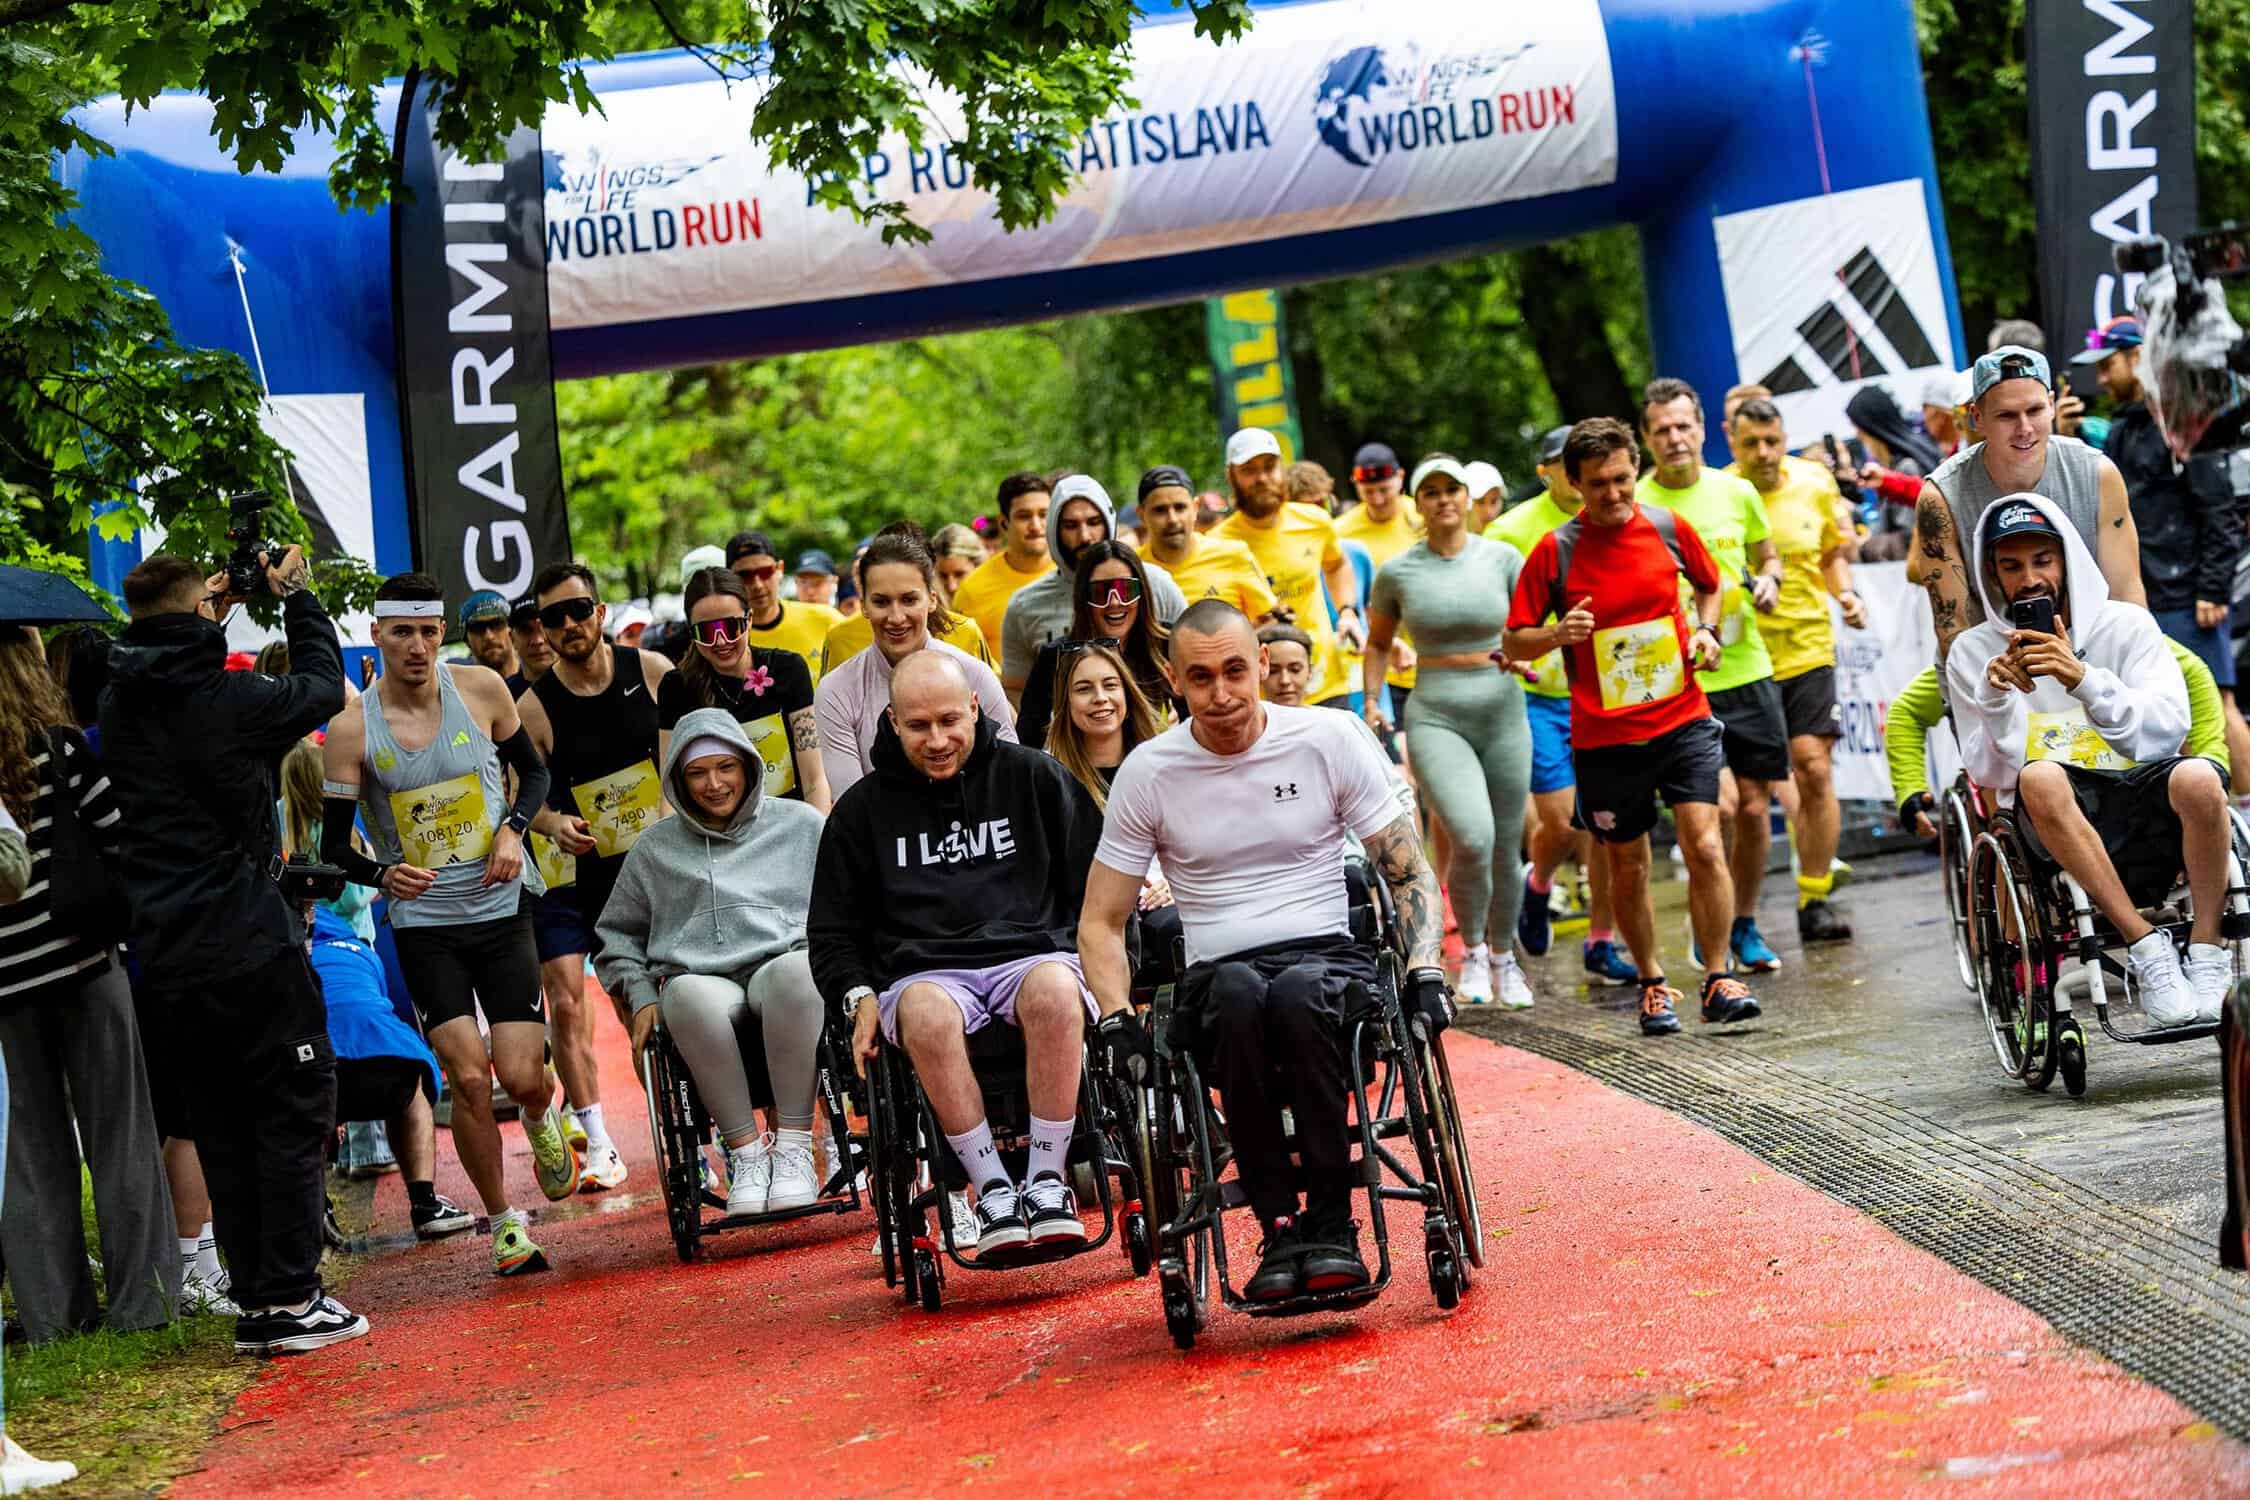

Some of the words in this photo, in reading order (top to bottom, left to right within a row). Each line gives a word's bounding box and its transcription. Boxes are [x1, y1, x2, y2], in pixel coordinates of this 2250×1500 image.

[1359, 97, 1495, 156] WORLD
[1500, 84, 1576, 134] RUN
[907, 136, 998, 194] RU
[1014, 100, 1272, 178] ATISLAVA
[546, 208, 678, 264] WORLD
[682, 196, 763, 248] RUN
[418, 820, 473, 845] 108120
[611, 807, 646, 829] 7490
[896, 837, 907, 867] I
